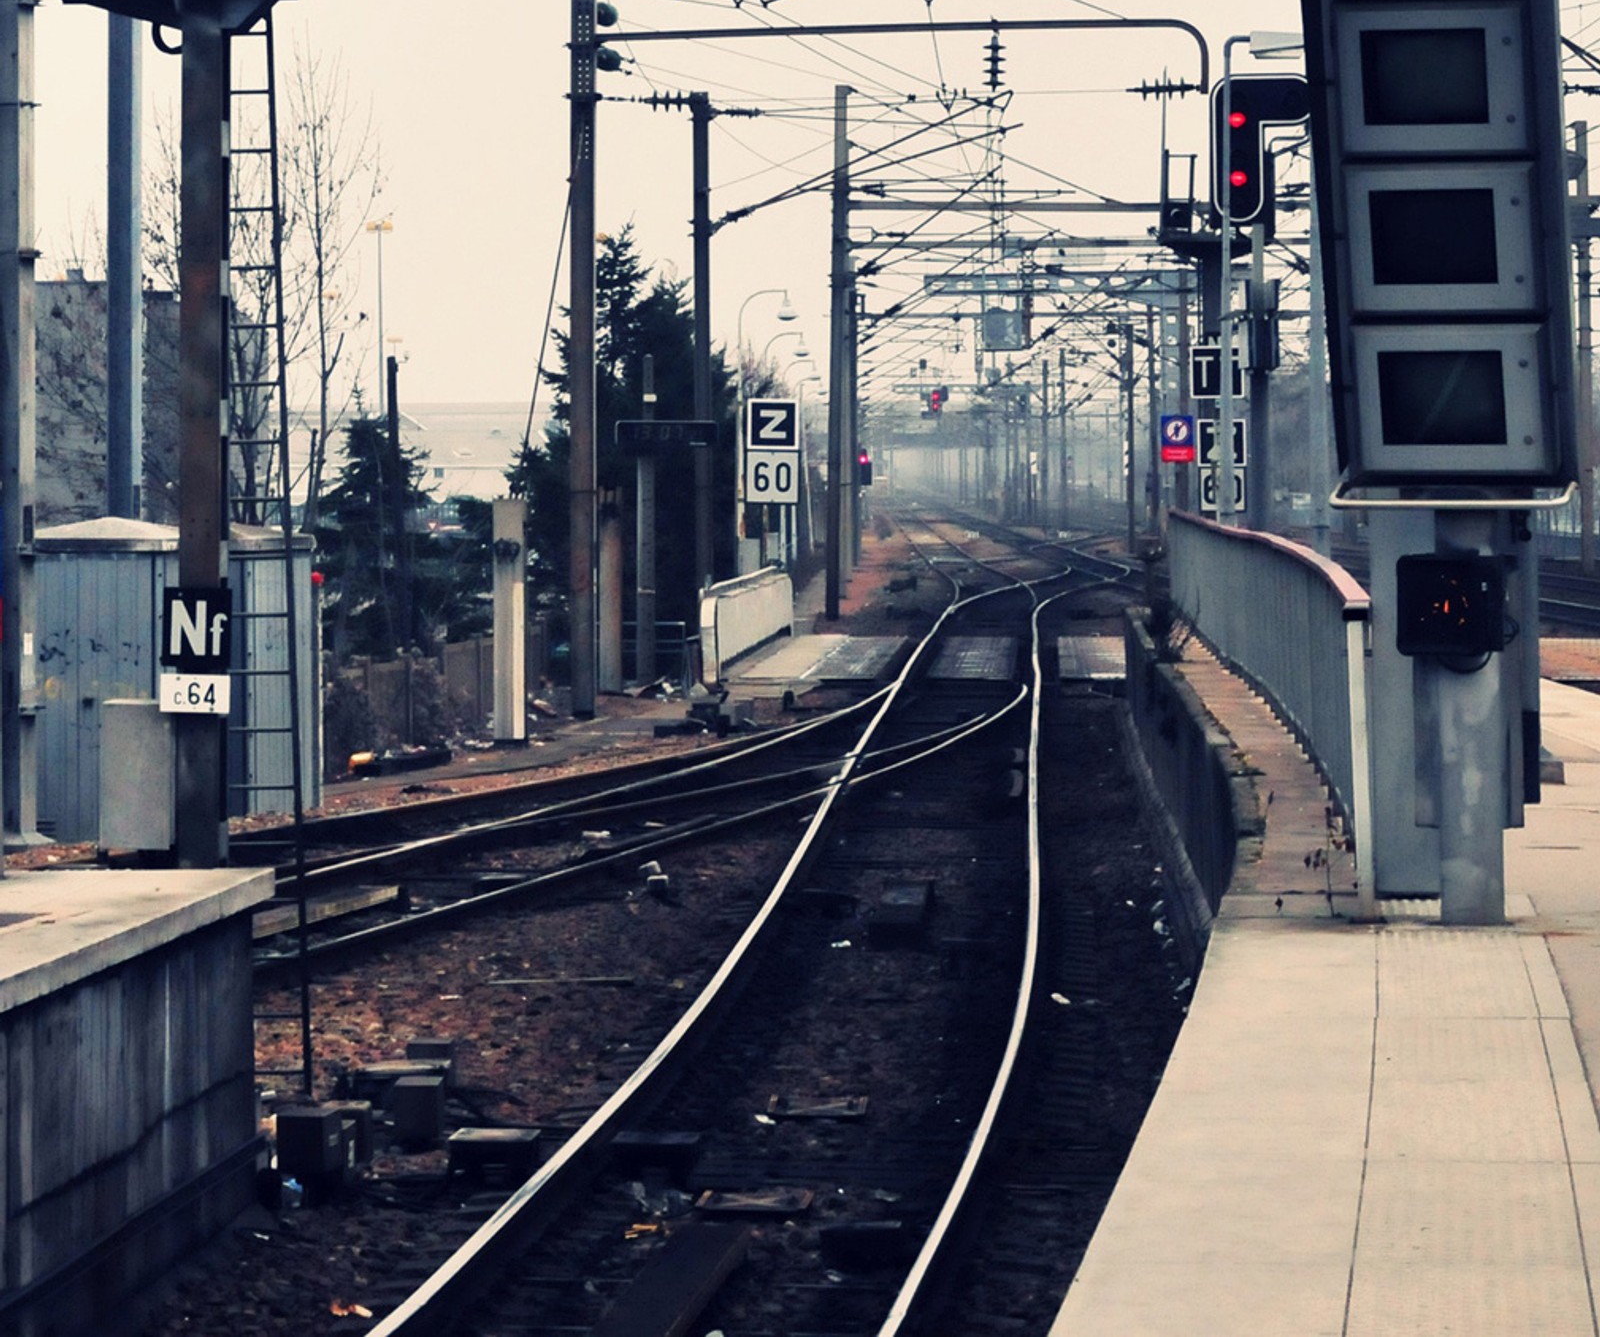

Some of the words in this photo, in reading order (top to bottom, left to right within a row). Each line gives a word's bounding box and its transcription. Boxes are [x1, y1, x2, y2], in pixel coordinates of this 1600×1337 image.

[760, 409, 787, 439] Z
[754, 461, 791, 492] 60
[170, 599, 228, 656] Nf
